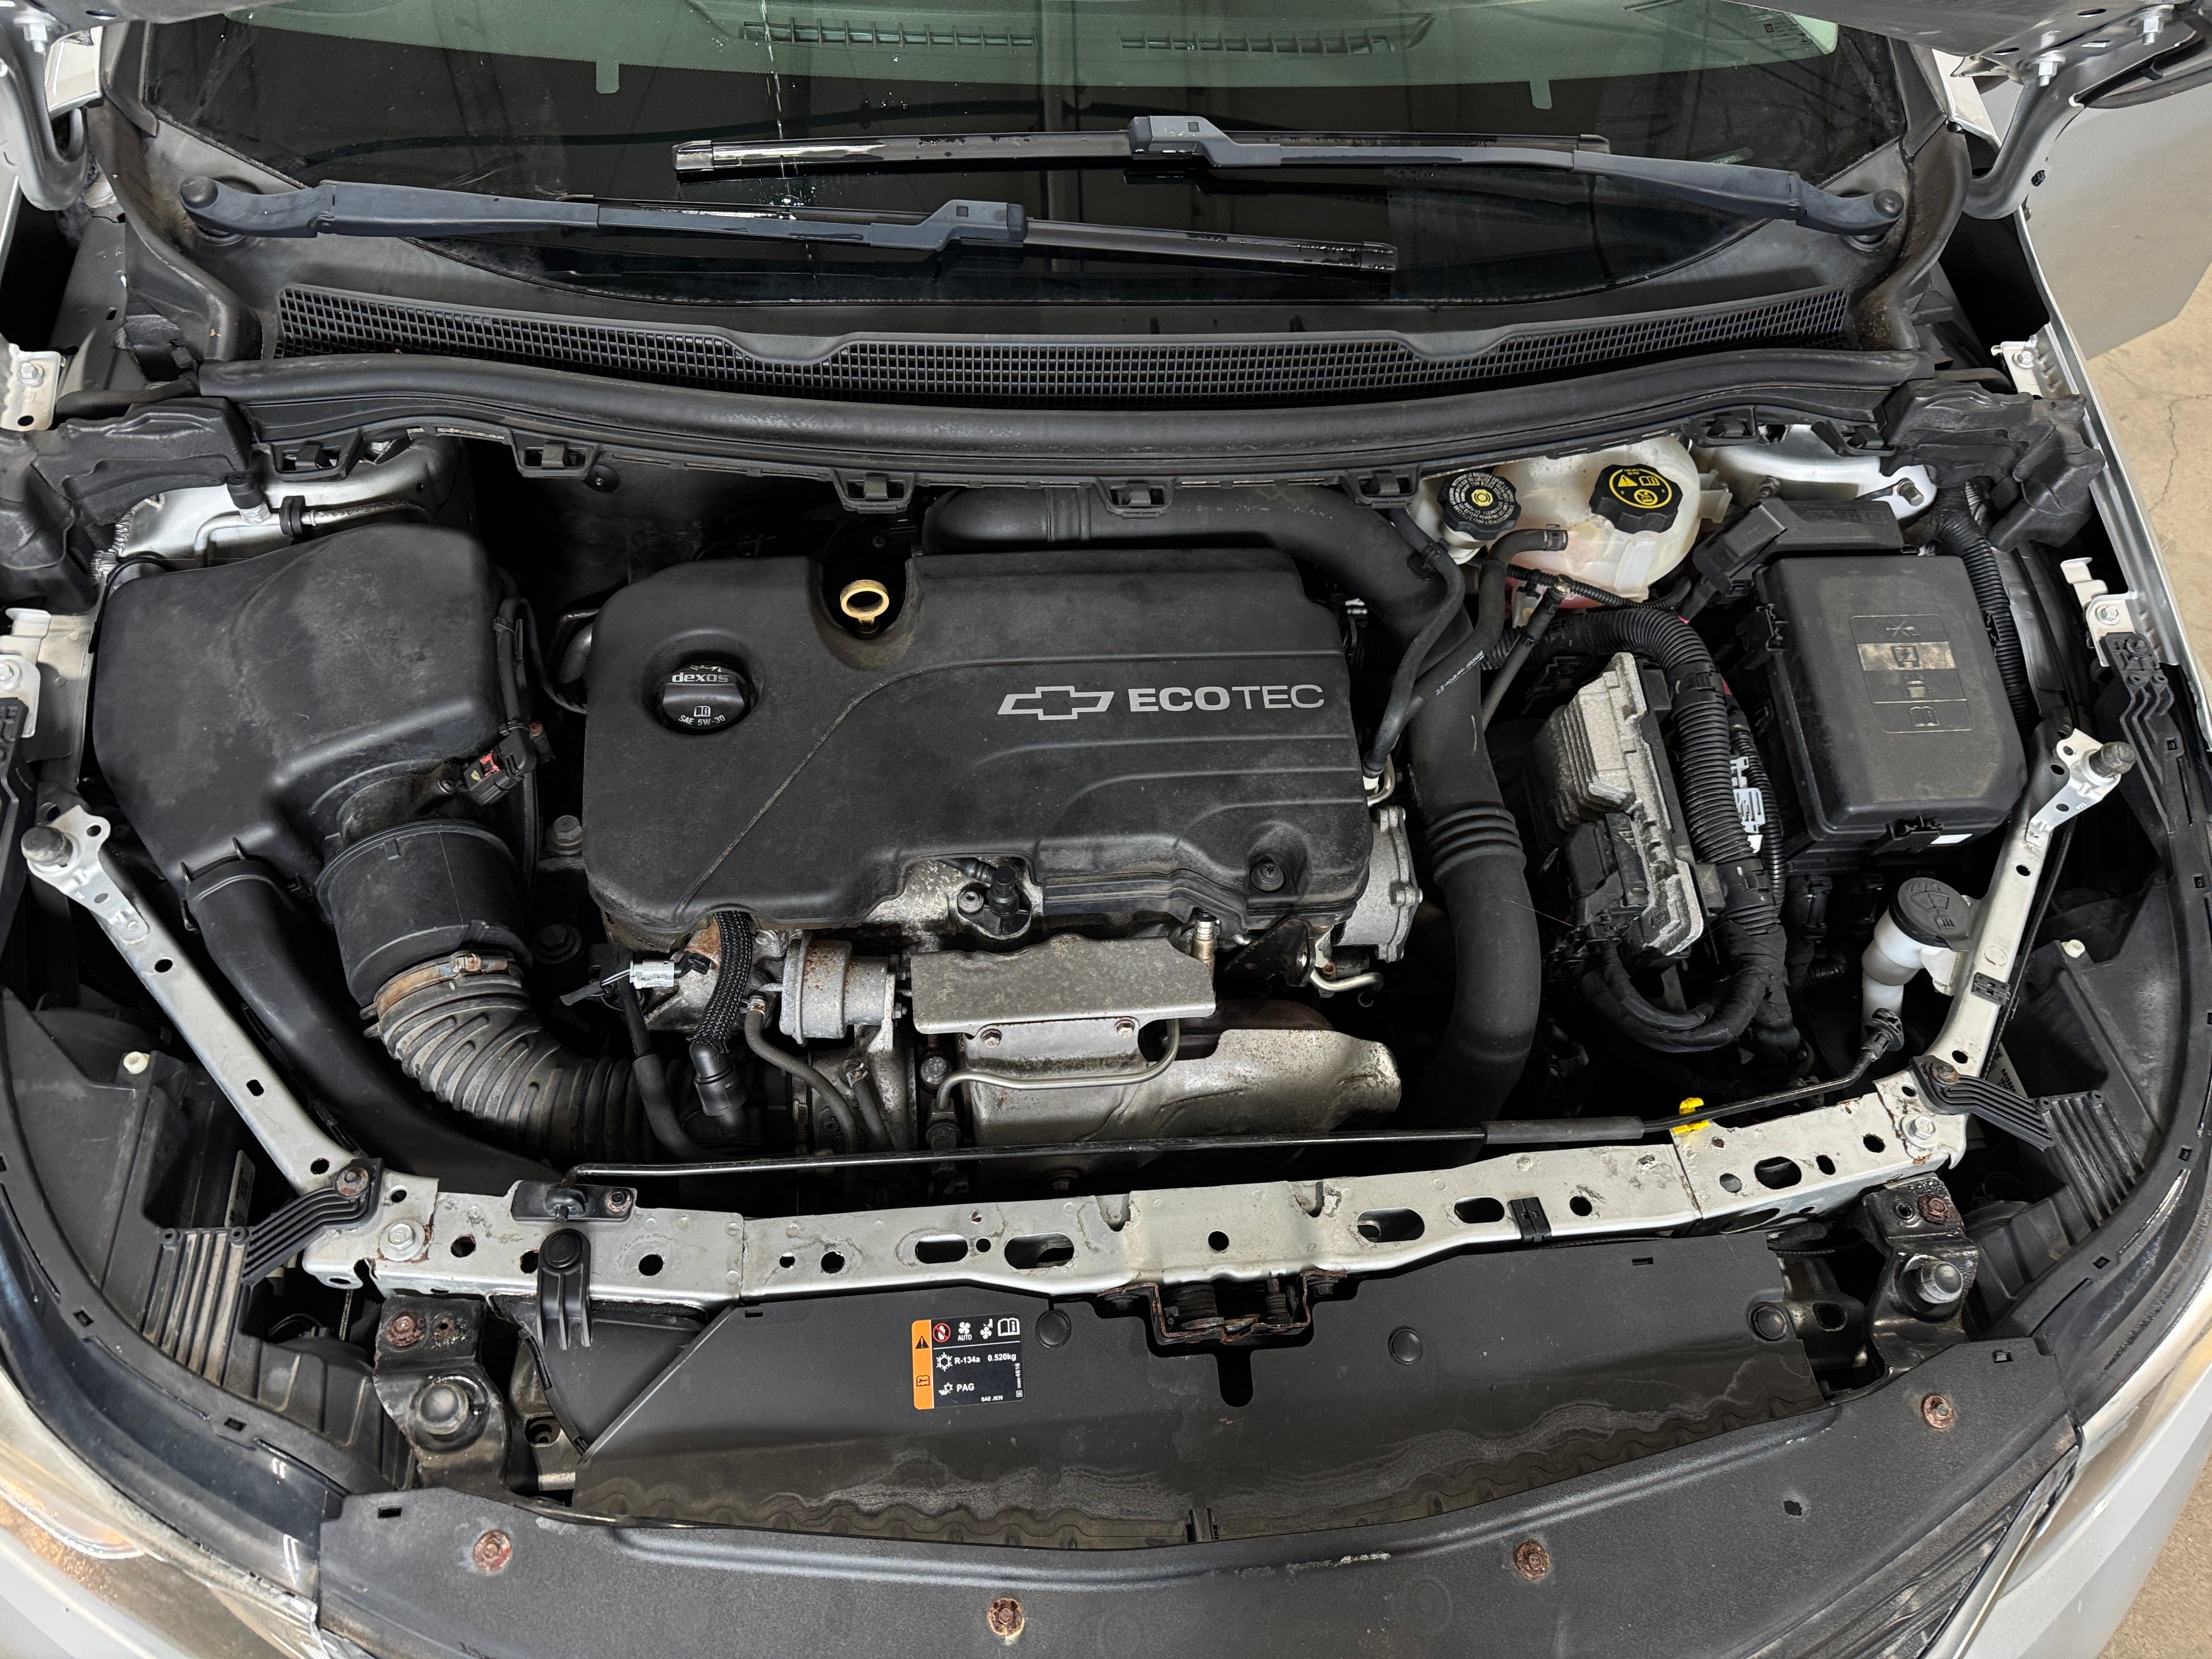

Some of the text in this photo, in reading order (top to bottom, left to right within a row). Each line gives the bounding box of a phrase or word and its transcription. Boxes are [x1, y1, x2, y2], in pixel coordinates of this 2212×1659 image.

[672, 672, 729, 682] dexos
[1128, 685, 1324, 712] ECOTEC
[678, 715, 726, 726] SAE 5W-30
[955, 1353, 1016, 1364] R-134a 0.520kg
[957, 1383, 975, 1392] PAG
